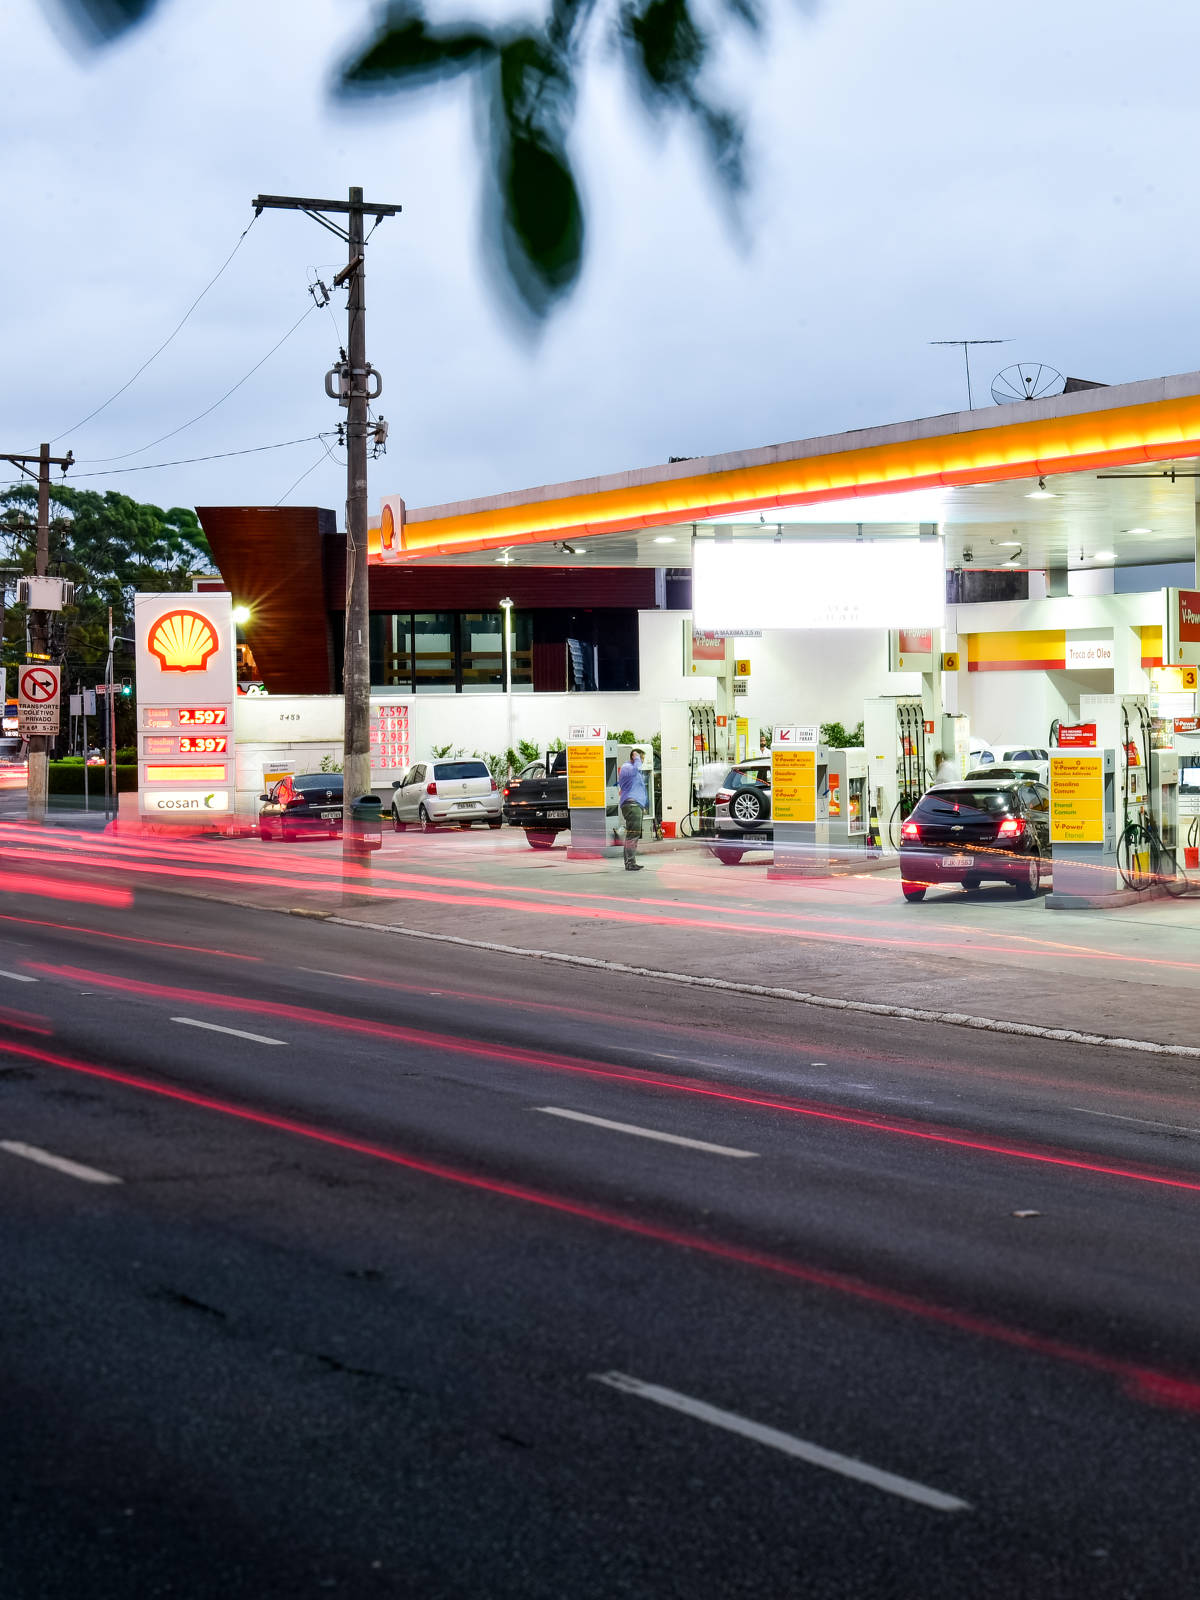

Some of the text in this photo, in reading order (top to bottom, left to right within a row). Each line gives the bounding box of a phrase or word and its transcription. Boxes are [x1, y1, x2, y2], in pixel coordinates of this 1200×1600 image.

[1087, 648, 1095, 659] de
[946, 656, 954, 667] 6
[740, 663, 747, 673] 8
[1186, 672, 1195, 684] 3
[180, 710, 225, 724] 2.597
[380, 706, 408, 717] 2.597
[380, 719, 409, 730] 2.697
[180, 738, 226, 752] 3.397
[380, 745, 409, 755] 3.397
[157, 799, 199, 809] cosan
